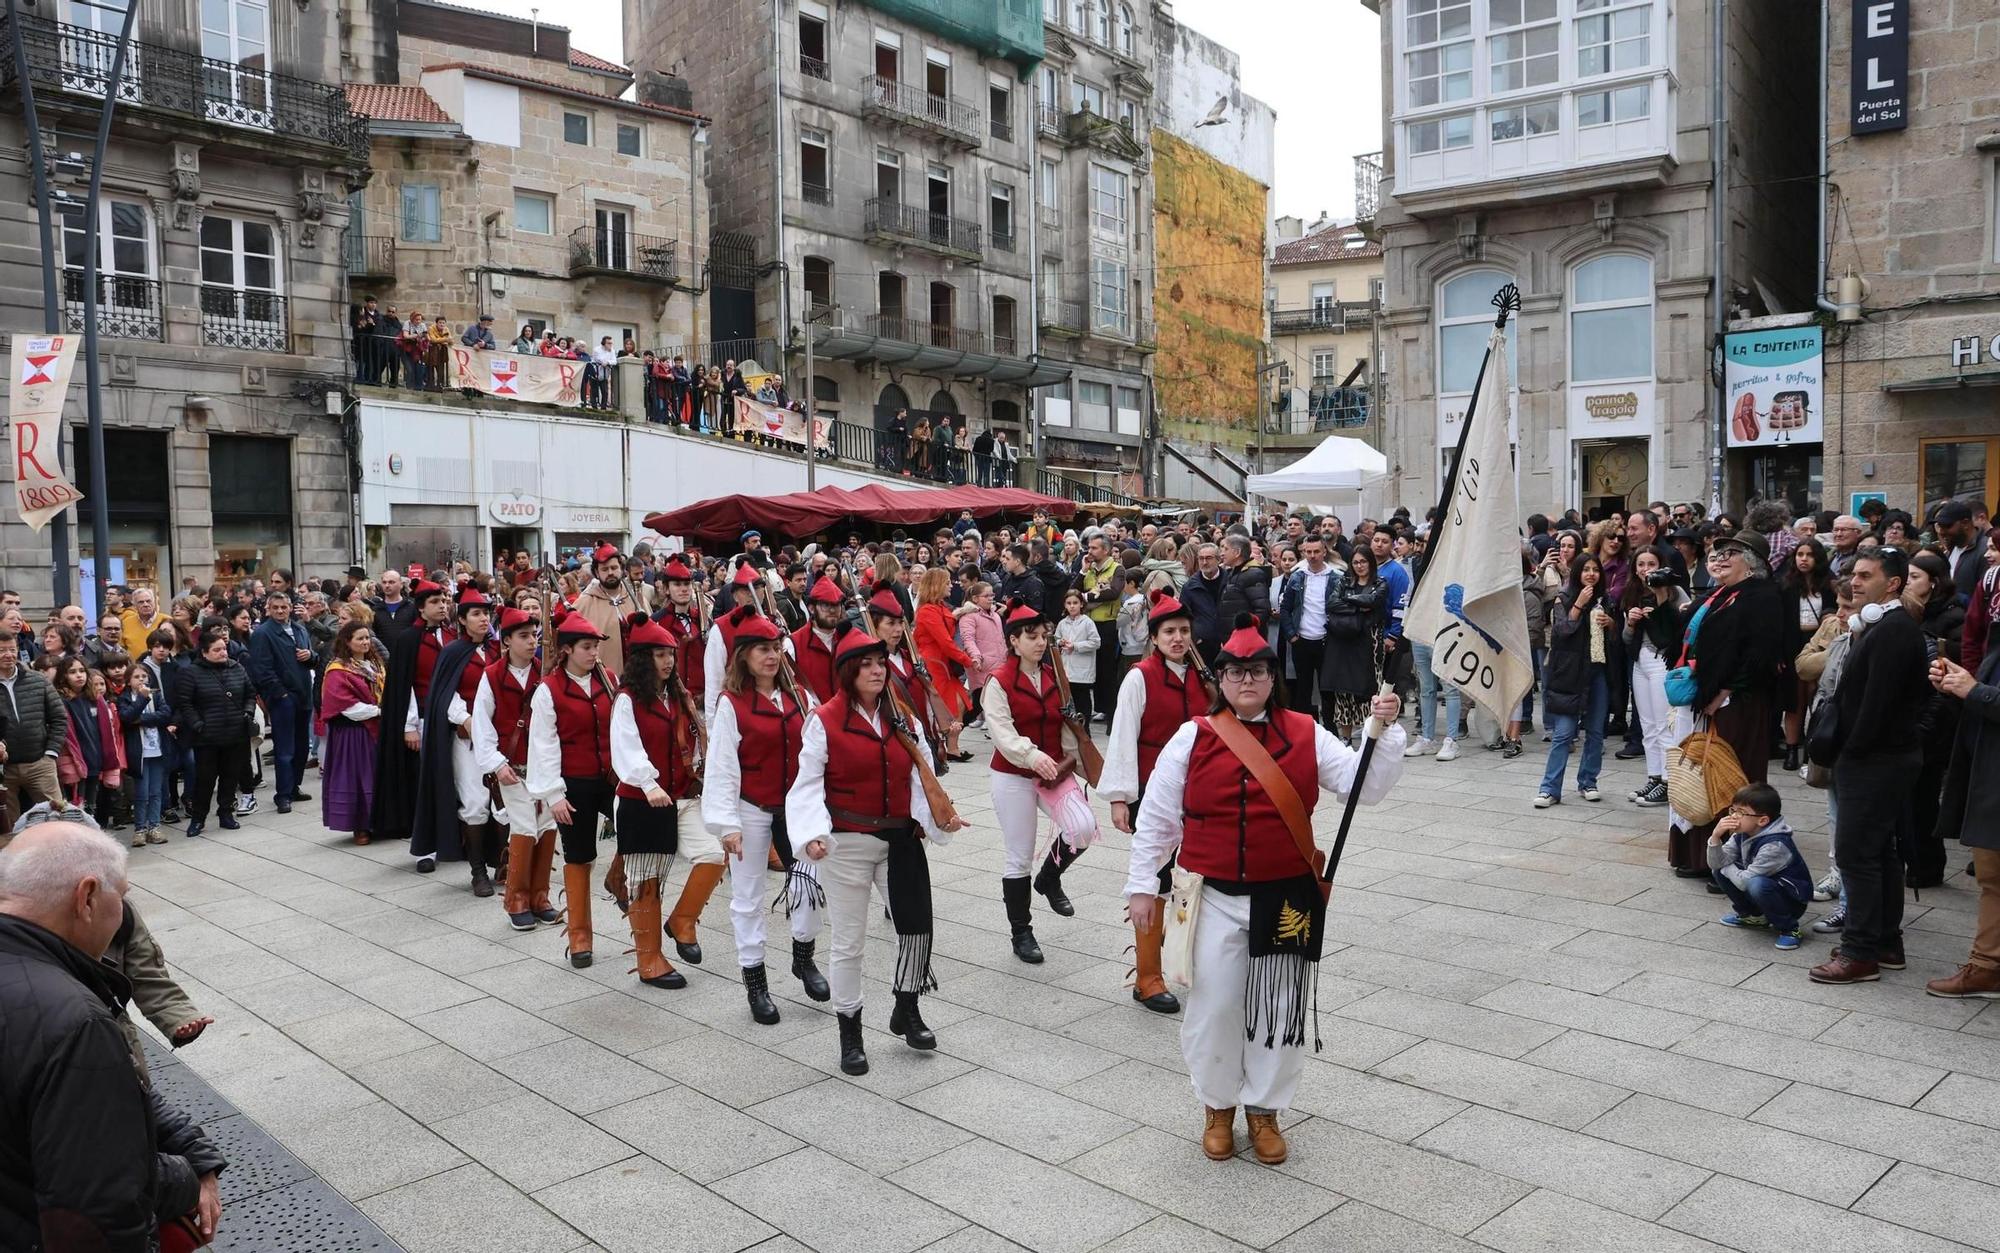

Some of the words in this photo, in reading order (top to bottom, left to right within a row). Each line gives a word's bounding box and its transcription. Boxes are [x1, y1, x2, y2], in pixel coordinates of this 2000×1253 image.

[1859, 99, 1900, 110] Puerta
[1858, 113, 1877, 123] del
[1880, 109, 1901, 120] Sol
[1733, 345, 1747, 356] LA
[1754, 339, 1815, 354] CONTENTA
[559, 363, 576, 392] R
[1587, 396, 1625, 409] panna
[15, 422, 57, 481] R
[19, 484, 71, 512] 1809
[500, 503, 536, 516] PATO
